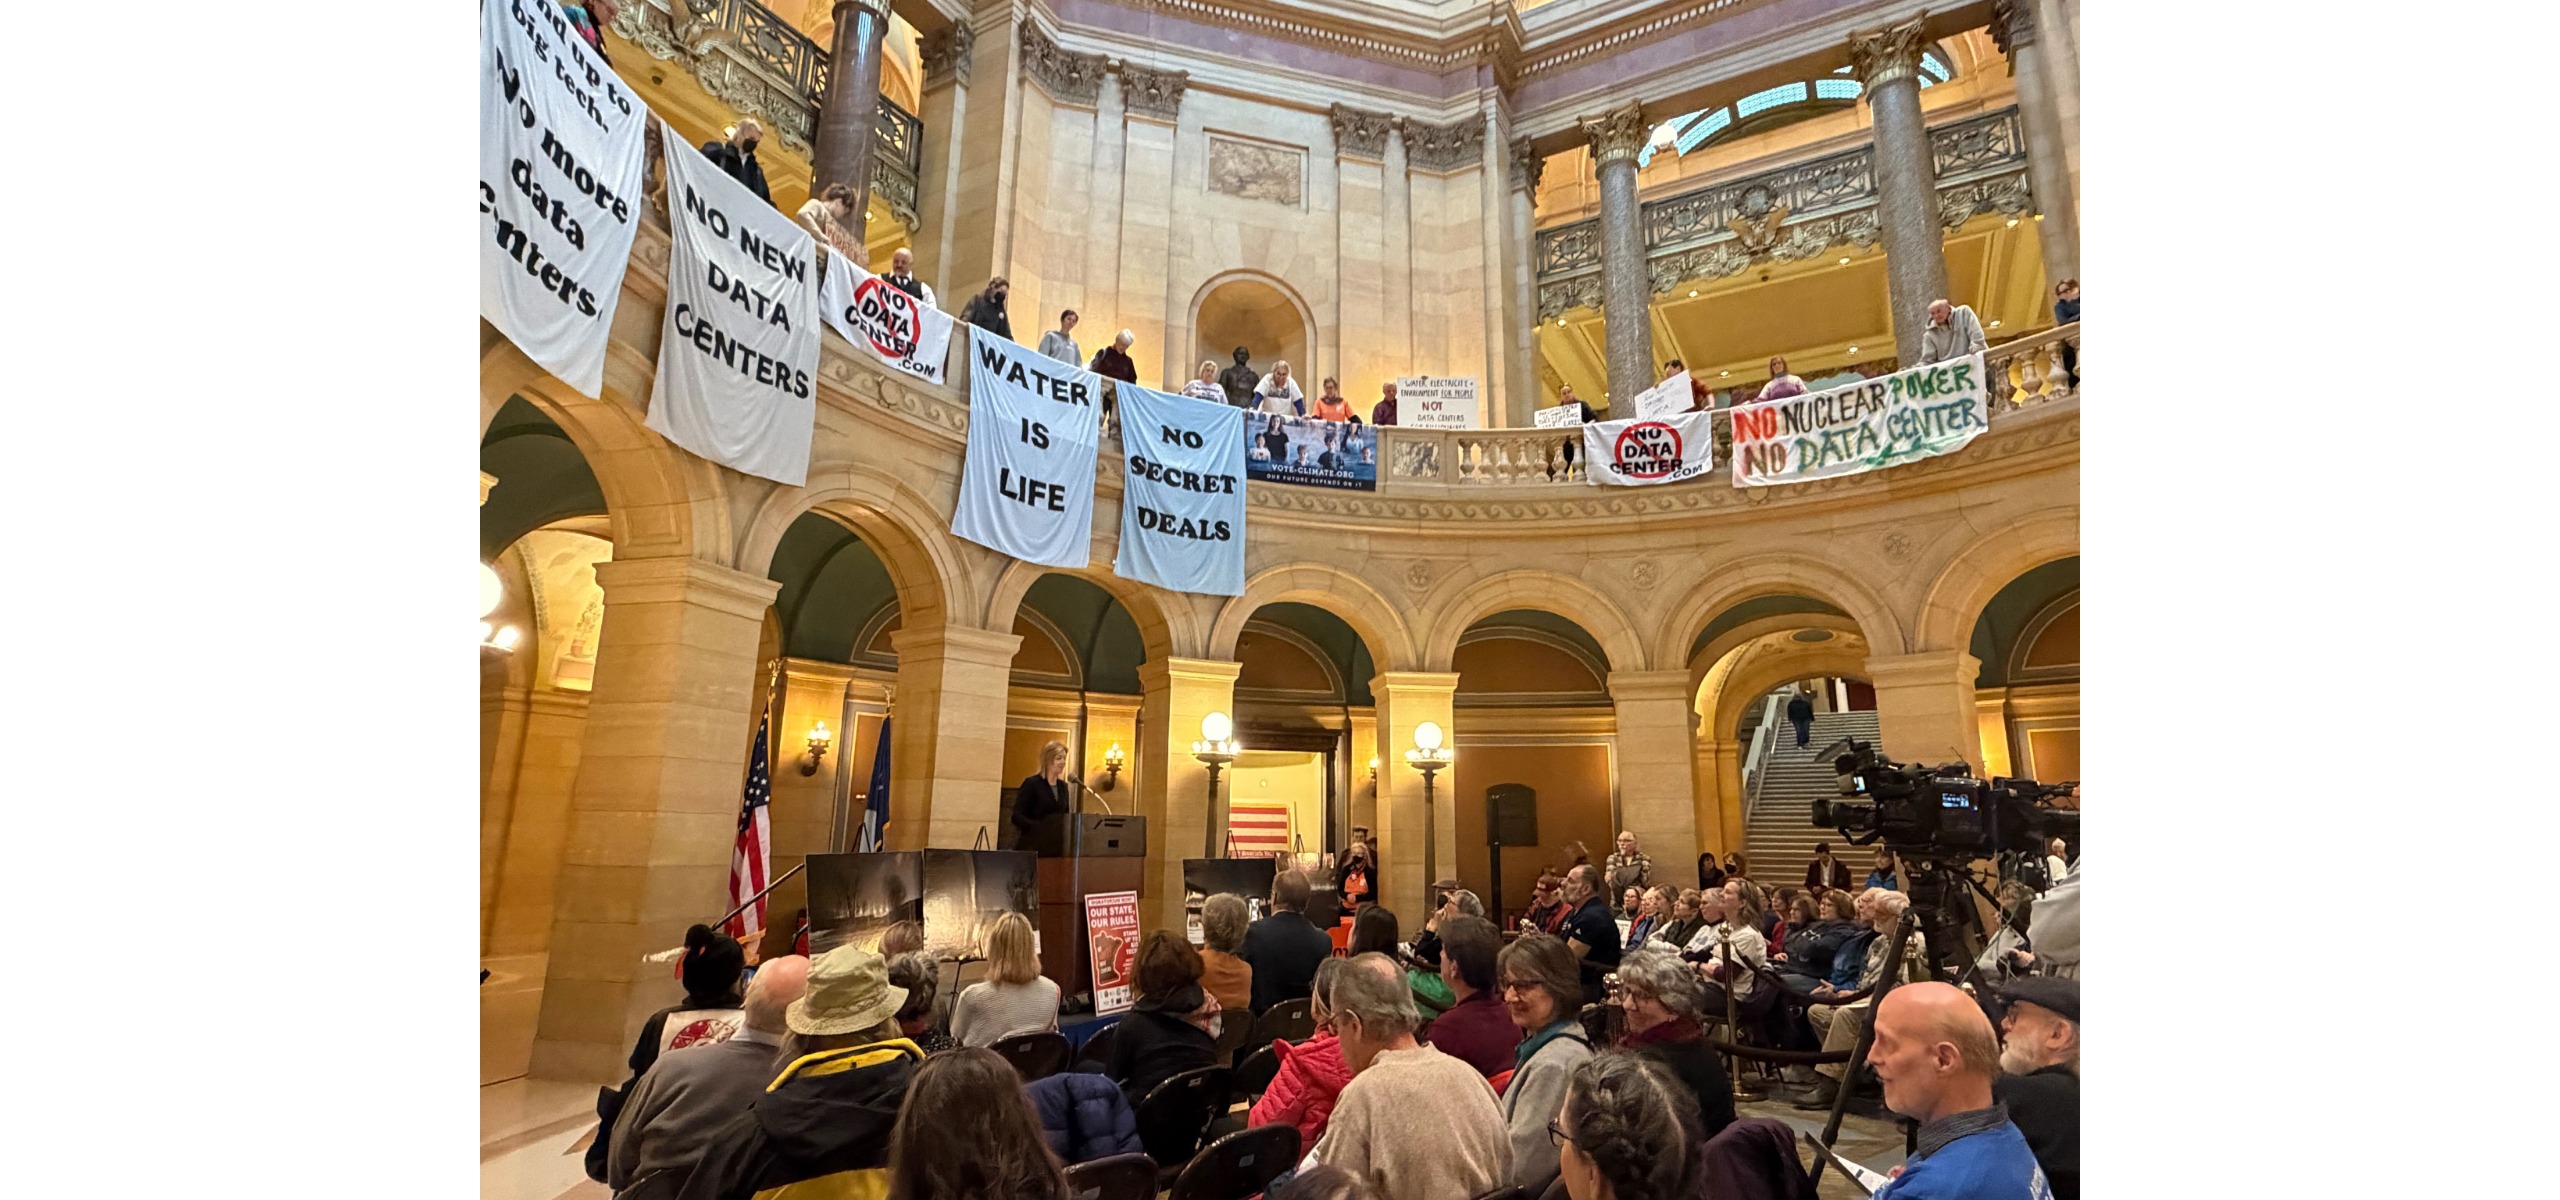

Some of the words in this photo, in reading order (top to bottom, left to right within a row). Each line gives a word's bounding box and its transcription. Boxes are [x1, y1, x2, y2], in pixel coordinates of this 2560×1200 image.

[512, 0, 549, 63] big
[555, 55, 609, 134] tech.
[533, 0, 566, 44] nd
[572, 41, 601, 88] up
[607, 82, 631, 116] to
[496, 46, 535, 128] No
[541, 127, 628, 225] more
[512, 158, 584, 251] data
[686, 183, 729, 239] NO
[741, 226, 806, 284] NEW
[708, 259, 791, 333] DATA
[879, 285, 906, 311] NO
[845, 305, 917, 360] CENTER
[861, 297, 910, 337] DATA
[675, 303, 809, 399] CENTERS
[898, 359, 936, 377] .COM
[978, 339, 1090, 407] WATER
[1422, 401, 1443, 411] NOT
[1441, 389, 1453, 397] FOR
[1455, 389, 1473, 397] PEOPLE
[1733, 407, 1777, 443] NO
[1783, 382, 1886, 435] NUCLEAR
[1889, 363, 1977, 404] POWER
[1021, 417, 1049, 450] IS
[1417, 414, 1434, 422] DATA
[1438, 414, 1465, 422] CENTERS
[1634, 427, 1662, 441] NO
[1162, 425, 1203, 449] NO
[1624, 442, 1673, 459] DATA
[1742, 442, 1787, 477] NO
[1795, 424, 1881, 473] DATA
[1886, 398, 1987, 441] CENTER
[1130, 455, 1237, 495] SECRET
[1283, 475, 1308, 483] FUTURE
[1311, 478, 1341, 486] DEPENDS
[1609, 459, 1683, 475] CENTER
[1668, 464, 1703, 481] .COM
[1000, 468, 1065, 512] LIFE
[1137, 506, 1231, 541] DEALS
[1090, 907, 1108, 918] OUR
[1109, 905, 1136, 916] STATE,
[1090, 917, 1109, 928] OUR
[1110, 915, 1137, 926] RULES.
